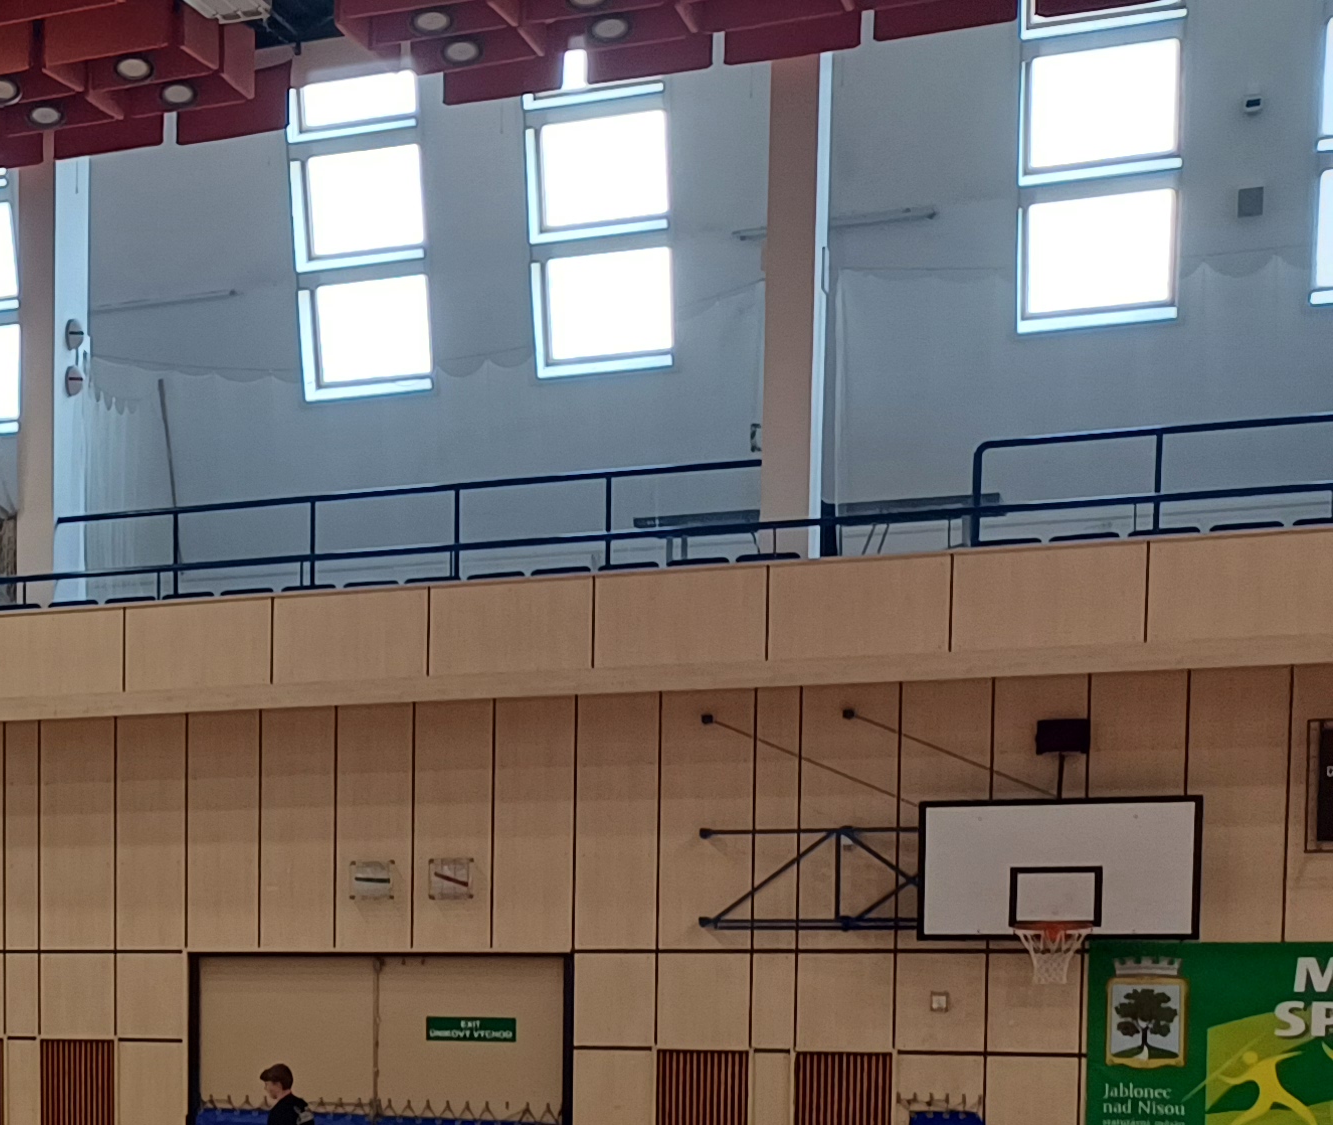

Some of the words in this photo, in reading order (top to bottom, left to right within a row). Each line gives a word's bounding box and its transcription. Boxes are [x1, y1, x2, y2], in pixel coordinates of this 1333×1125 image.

[460, 1019, 480, 1028] EXIT
[1103, 1082, 1172, 1099] Jablonec
[1103, 1099, 1132, 1114] nad
[1138, 1100, 1185, 1116] Nisou
